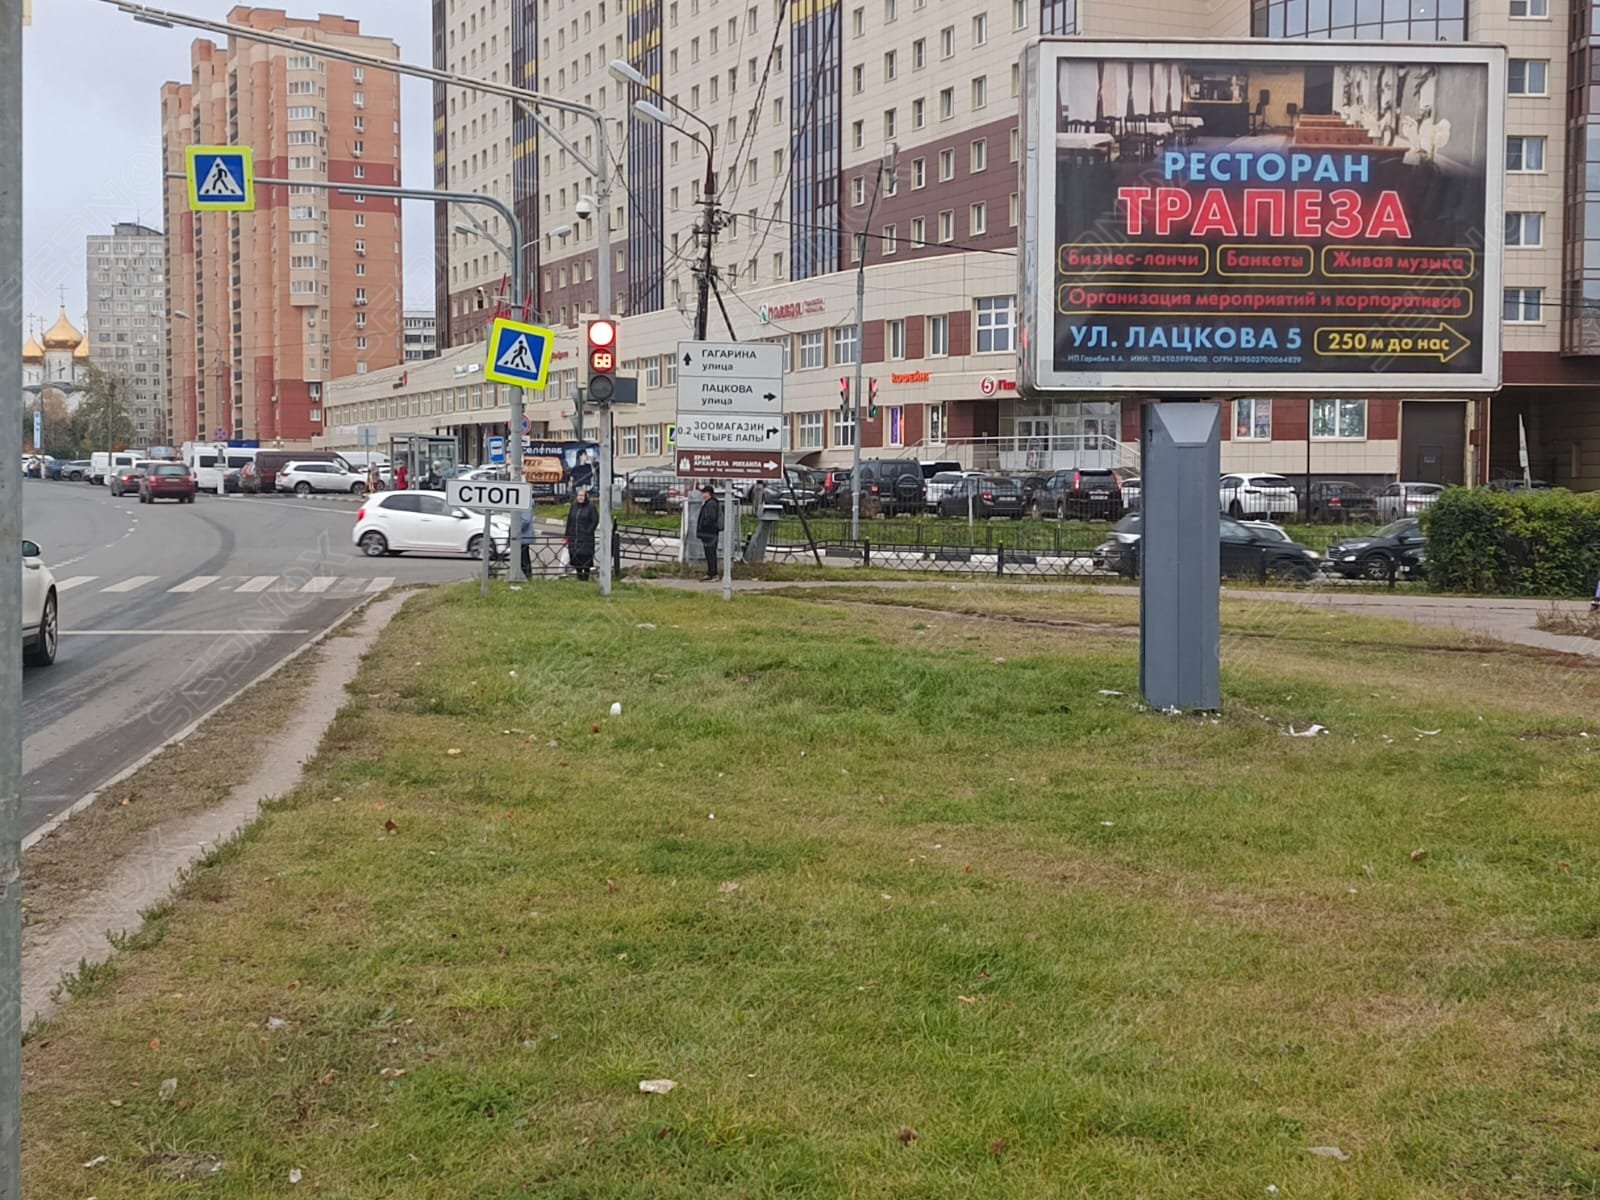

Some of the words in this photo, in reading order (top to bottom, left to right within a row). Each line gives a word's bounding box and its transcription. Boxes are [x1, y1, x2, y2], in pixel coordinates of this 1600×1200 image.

[1164, 151, 1369, 183] РЕСТОРАН
[1119, 187, 1411, 238] ТРАПЕЗА
[1068, 250, 1199, 269] Бизнес-ланчи
[1227, 251, 1304, 268] Банкеты
[1333, 252, 1395, 270] Живая
[1398, 255, 1464, 273] музыка
[1069, 290, 1192, 308] Организация
[1197, 290, 1316, 309] мероприятий
[1321, 296, 1333, 306] и
[1336, 294, 1461, 310] корпоративов
[1071, 327, 1118, 348] УЛ.
[1126, 327, 1278, 352] ЛАЦКОВА
[1287, 328, 1302, 349] 5
[1329, 333, 1367, 350] 250
[1371, 339, 1385, 350] м
[1388, 339, 1413, 353] до
[1418, 339, 1450, 352] нас
[594, 353, 612, 368] 68
[702, 349, 757, 360] ГАГАРИНА
[702, 363, 733, 372] улица
[702, 384, 753, 394] ЛАЦКОВА
[702, 397, 732, 406] улица
[678, 427, 691, 435] 0.2
[694, 421, 764, 431] ЗООМАГАЗИН
[694, 433, 732, 442] ЧЕТЫРЕ
[736, 434, 764, 442] ЛАПЫ
[459, 486, 520, 504] СТОП
